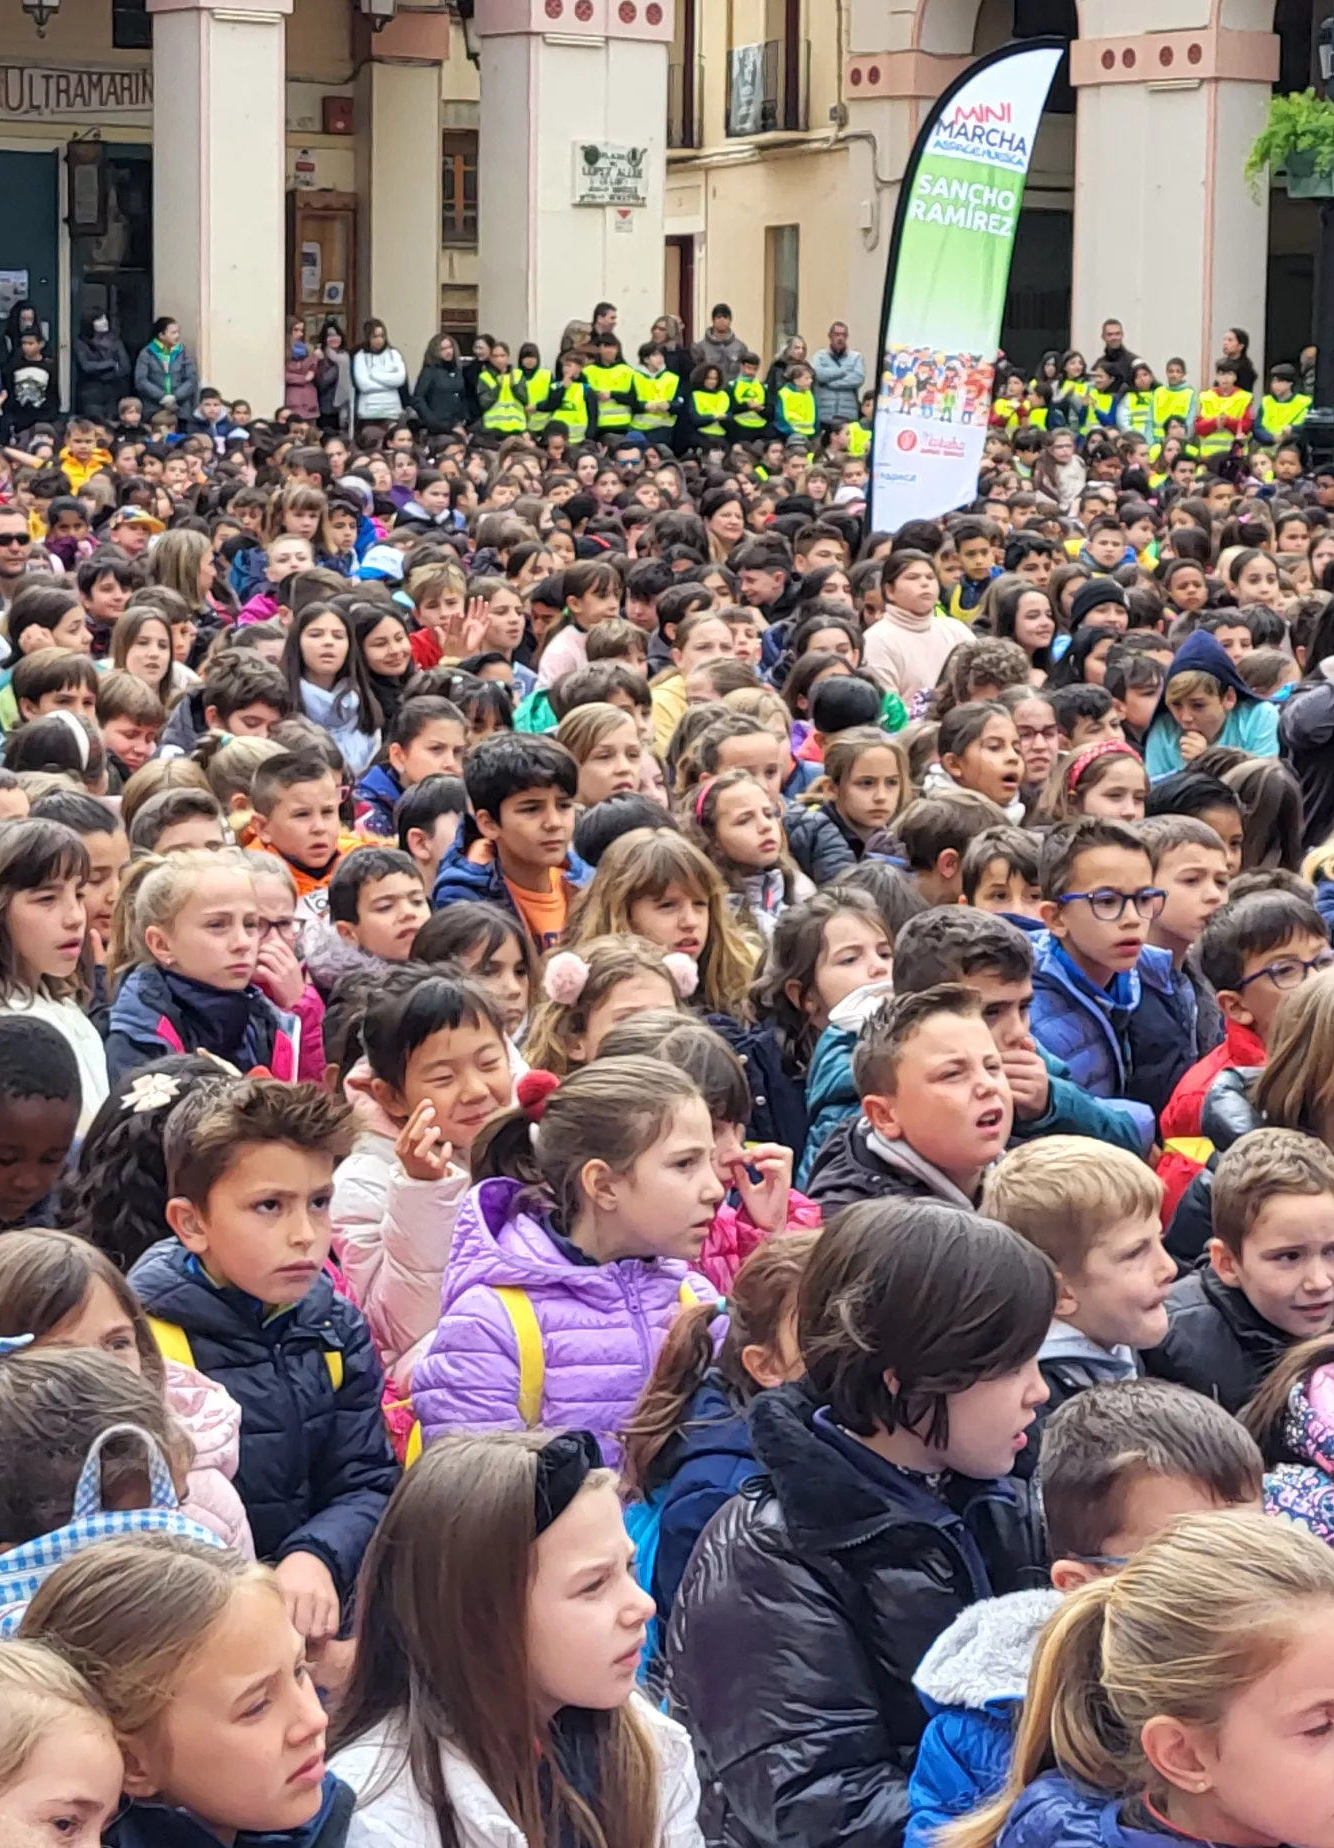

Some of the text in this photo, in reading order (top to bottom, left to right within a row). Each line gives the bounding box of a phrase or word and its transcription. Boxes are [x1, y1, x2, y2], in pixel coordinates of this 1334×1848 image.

[4, 68, 154, 112] ULTRAMARIN
[952, 102, 1011, 125] MINI
[935, 119, 1027, 156] MARCHA
[918, 174, 1016, 211] SANCHO
[909, 197, 1015, 237] RAMÍREZ
